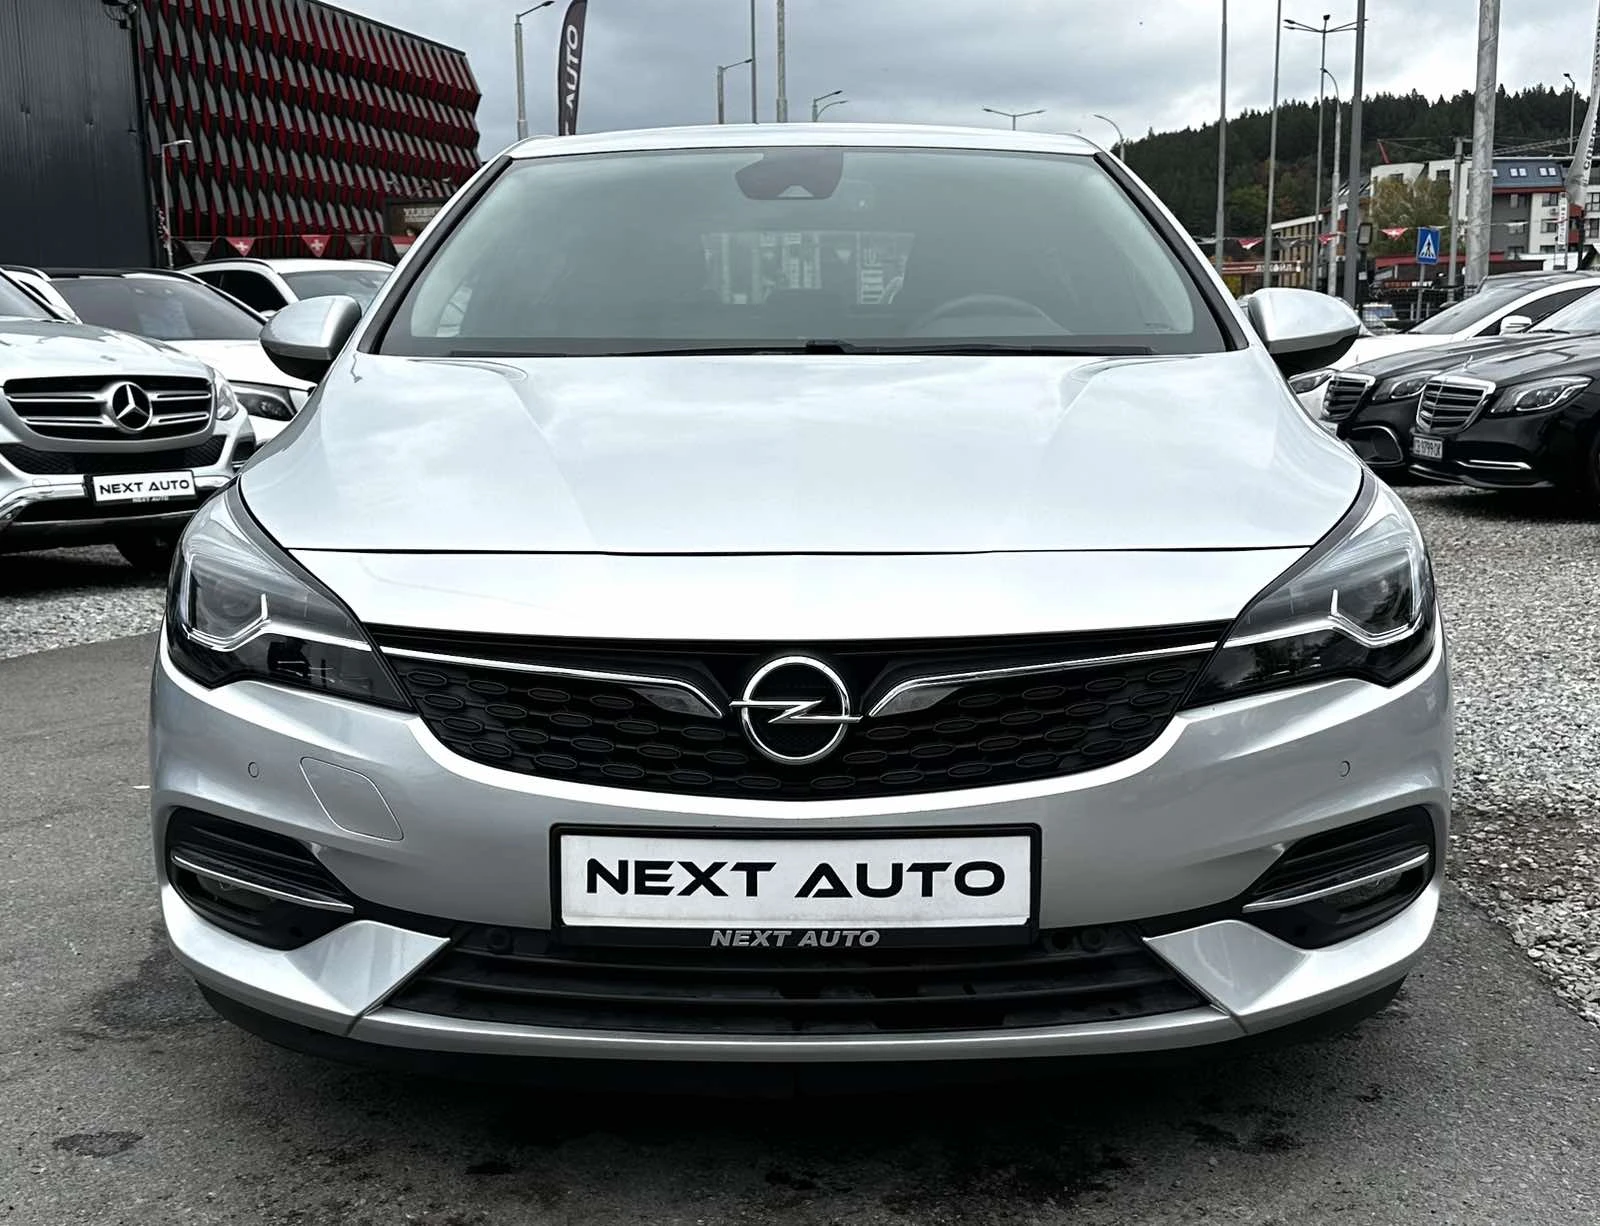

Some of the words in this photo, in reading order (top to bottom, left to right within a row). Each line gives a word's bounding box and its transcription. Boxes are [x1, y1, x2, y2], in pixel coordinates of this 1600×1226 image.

[566, 24, 579, 111] AUTO
[99, 482, 144, 495] NEXT
[148, 479, 190, 491] AUTO
[586, 858, 777, 897] NEXT
[794, 861, 1006, 898] AUTO
[711, 930, 792, 948] NEXT
[798, 929, 881, 947] AUTO
